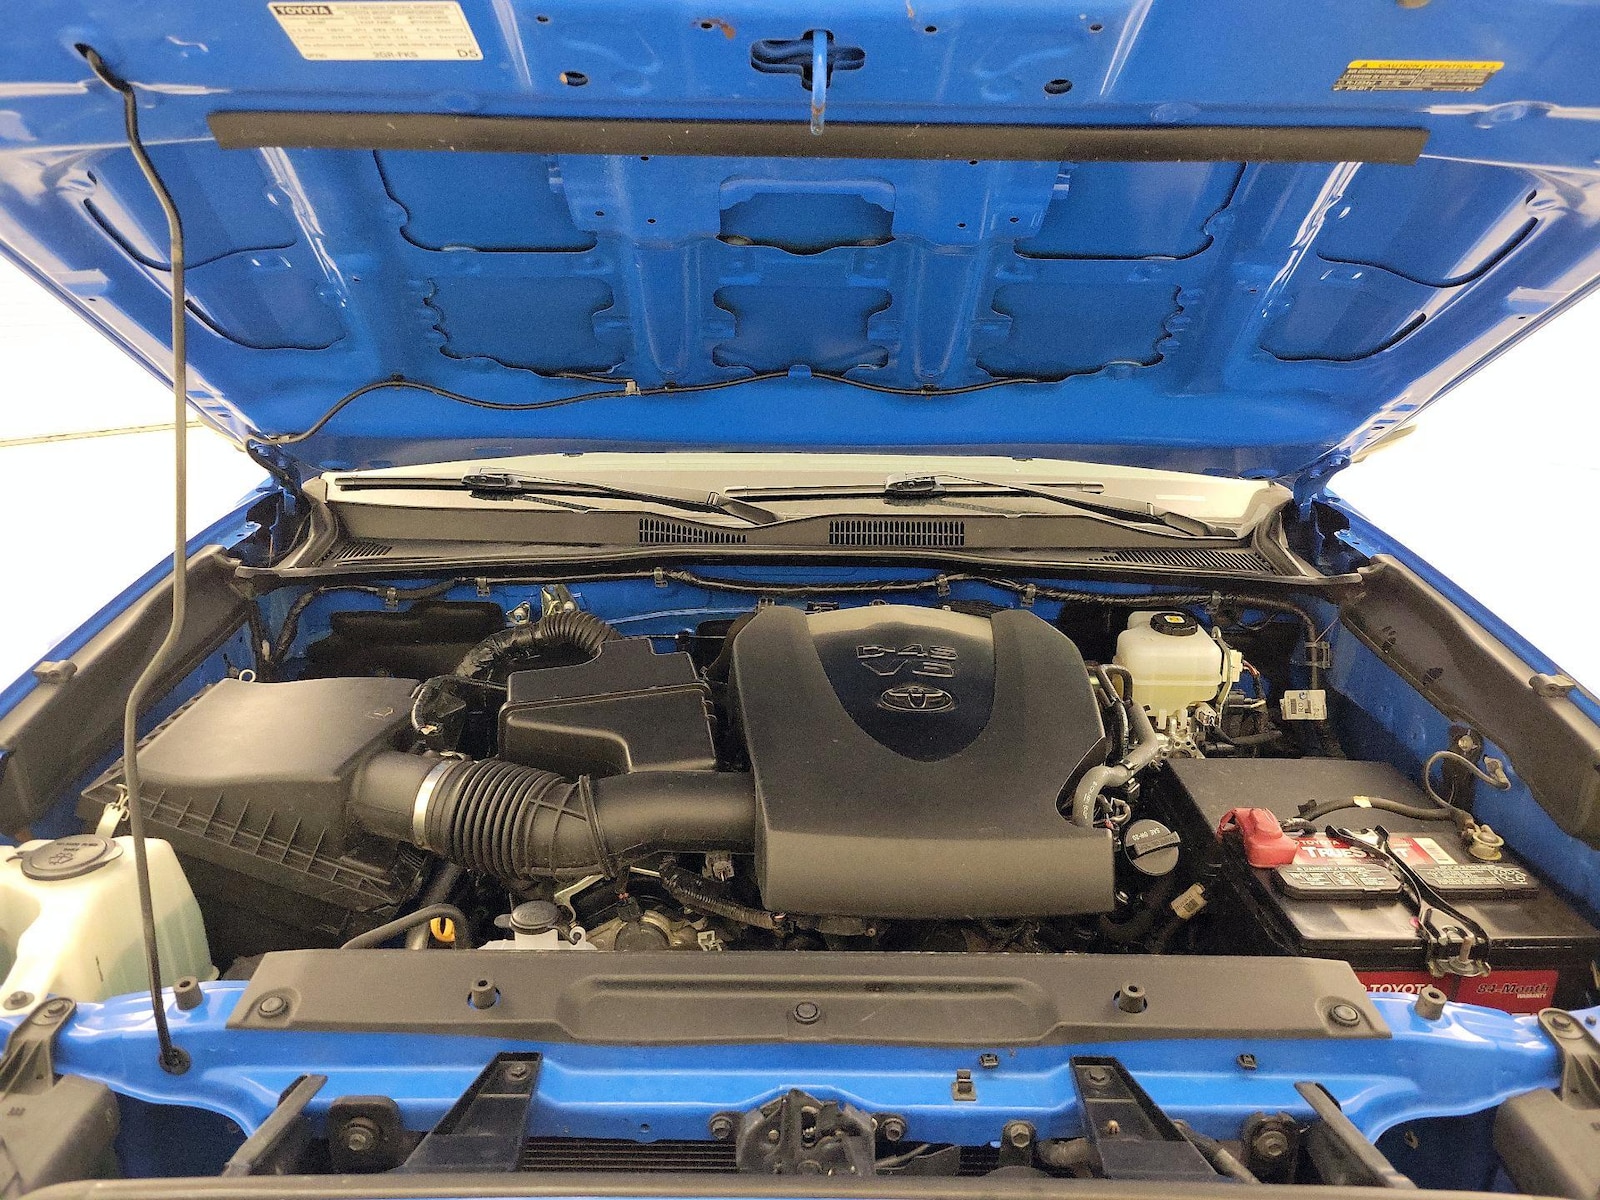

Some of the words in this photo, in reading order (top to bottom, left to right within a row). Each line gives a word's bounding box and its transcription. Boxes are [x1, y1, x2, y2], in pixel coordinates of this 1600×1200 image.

[278, 6, 331, 15] TOYOTA
[1370, 983, 1434, 994] TOYOT
[1477, 983, 1550, 994] 84-Month
